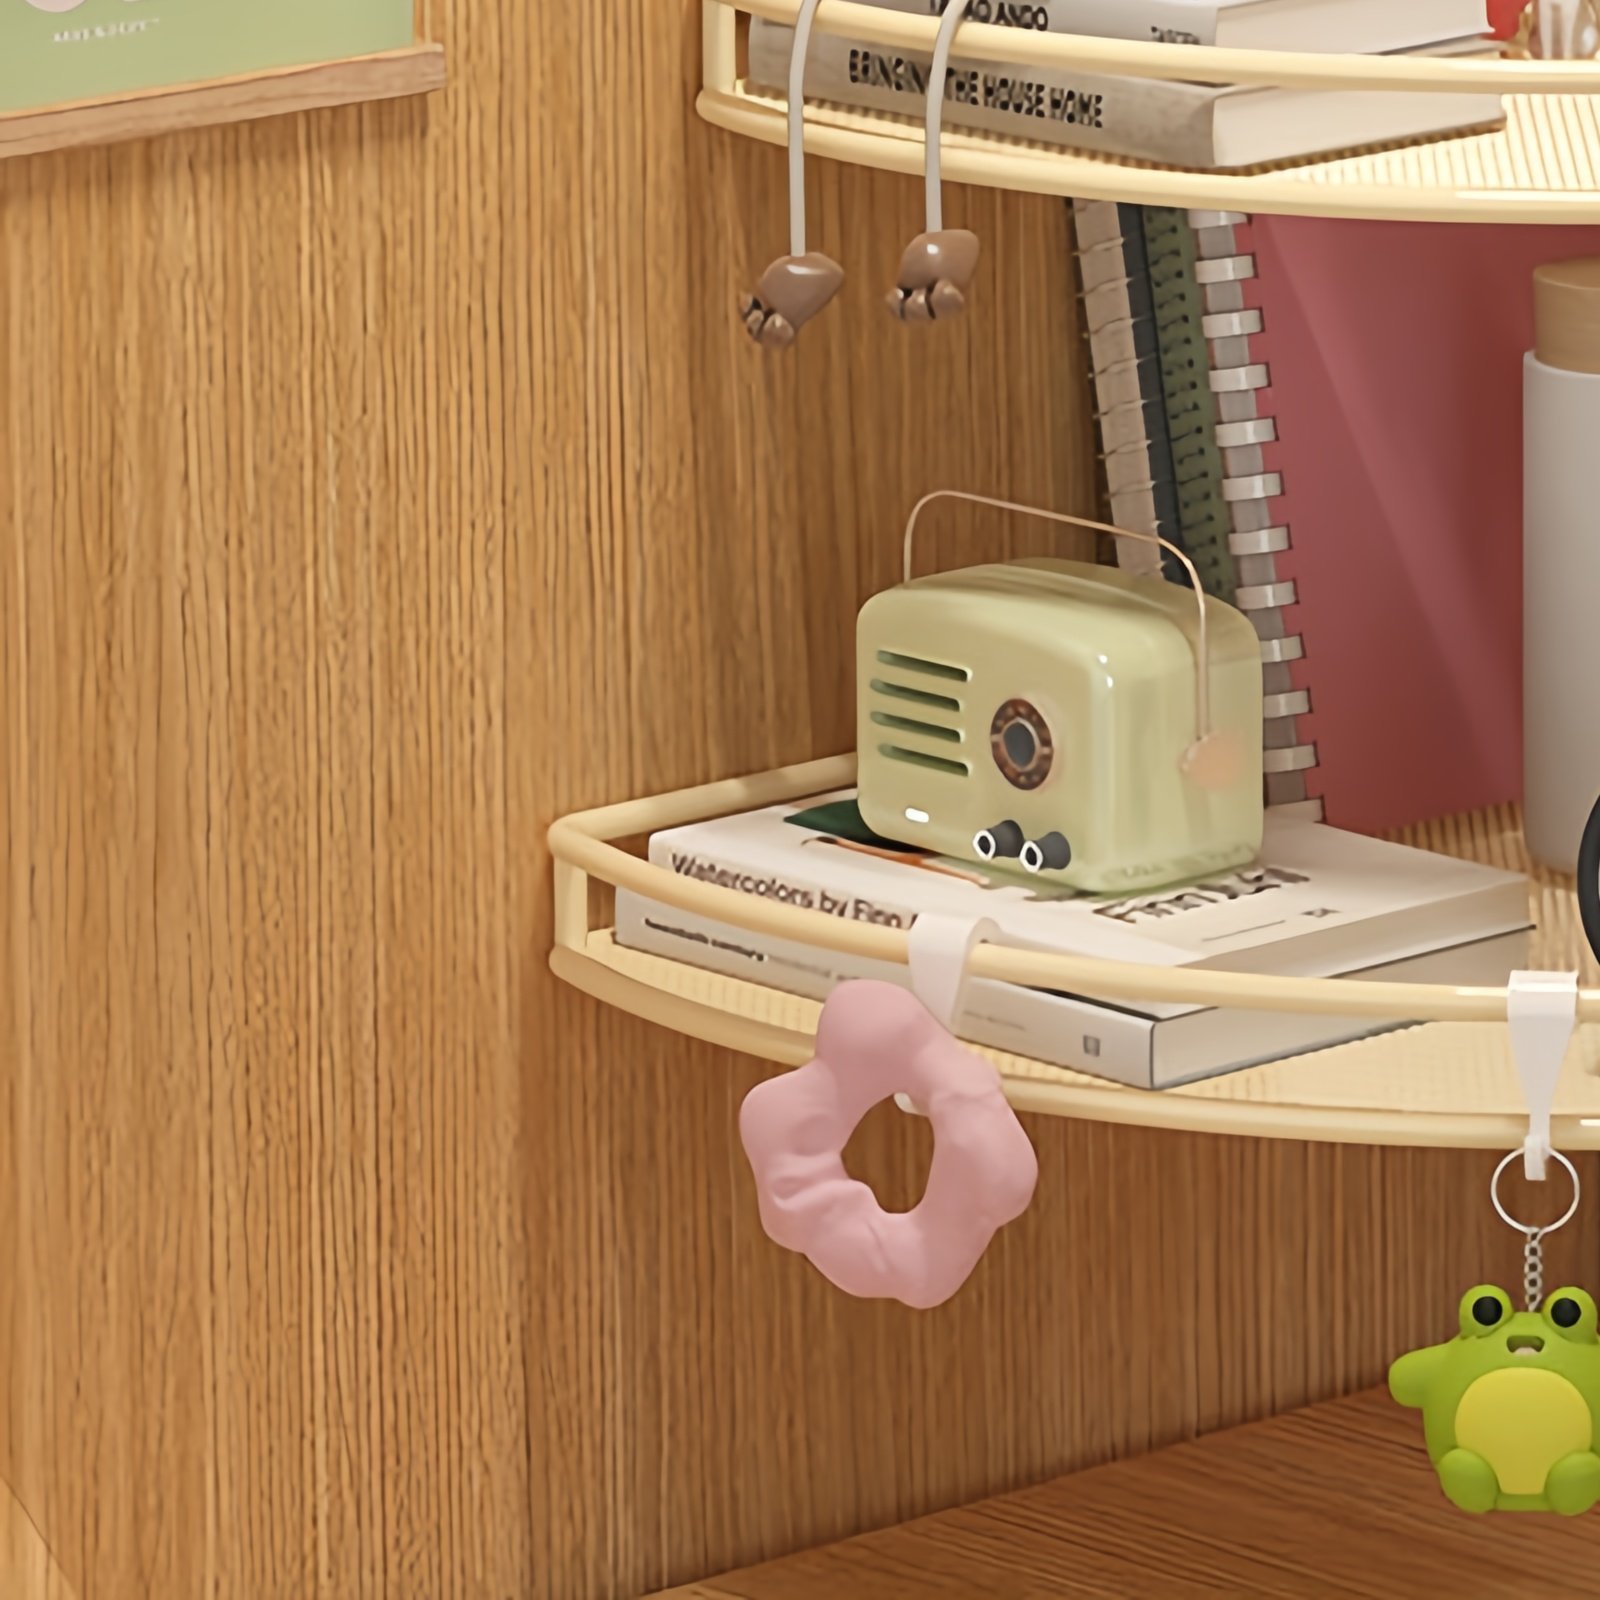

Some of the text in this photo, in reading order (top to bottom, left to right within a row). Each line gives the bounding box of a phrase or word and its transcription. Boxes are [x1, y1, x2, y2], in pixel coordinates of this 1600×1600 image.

[983, 74, 1045, 119] HOUSE
[1049, 87, 1103, 129] HOME
[671, 853, 814, 910] Watercolors
[820, 890, 848, 917] by
